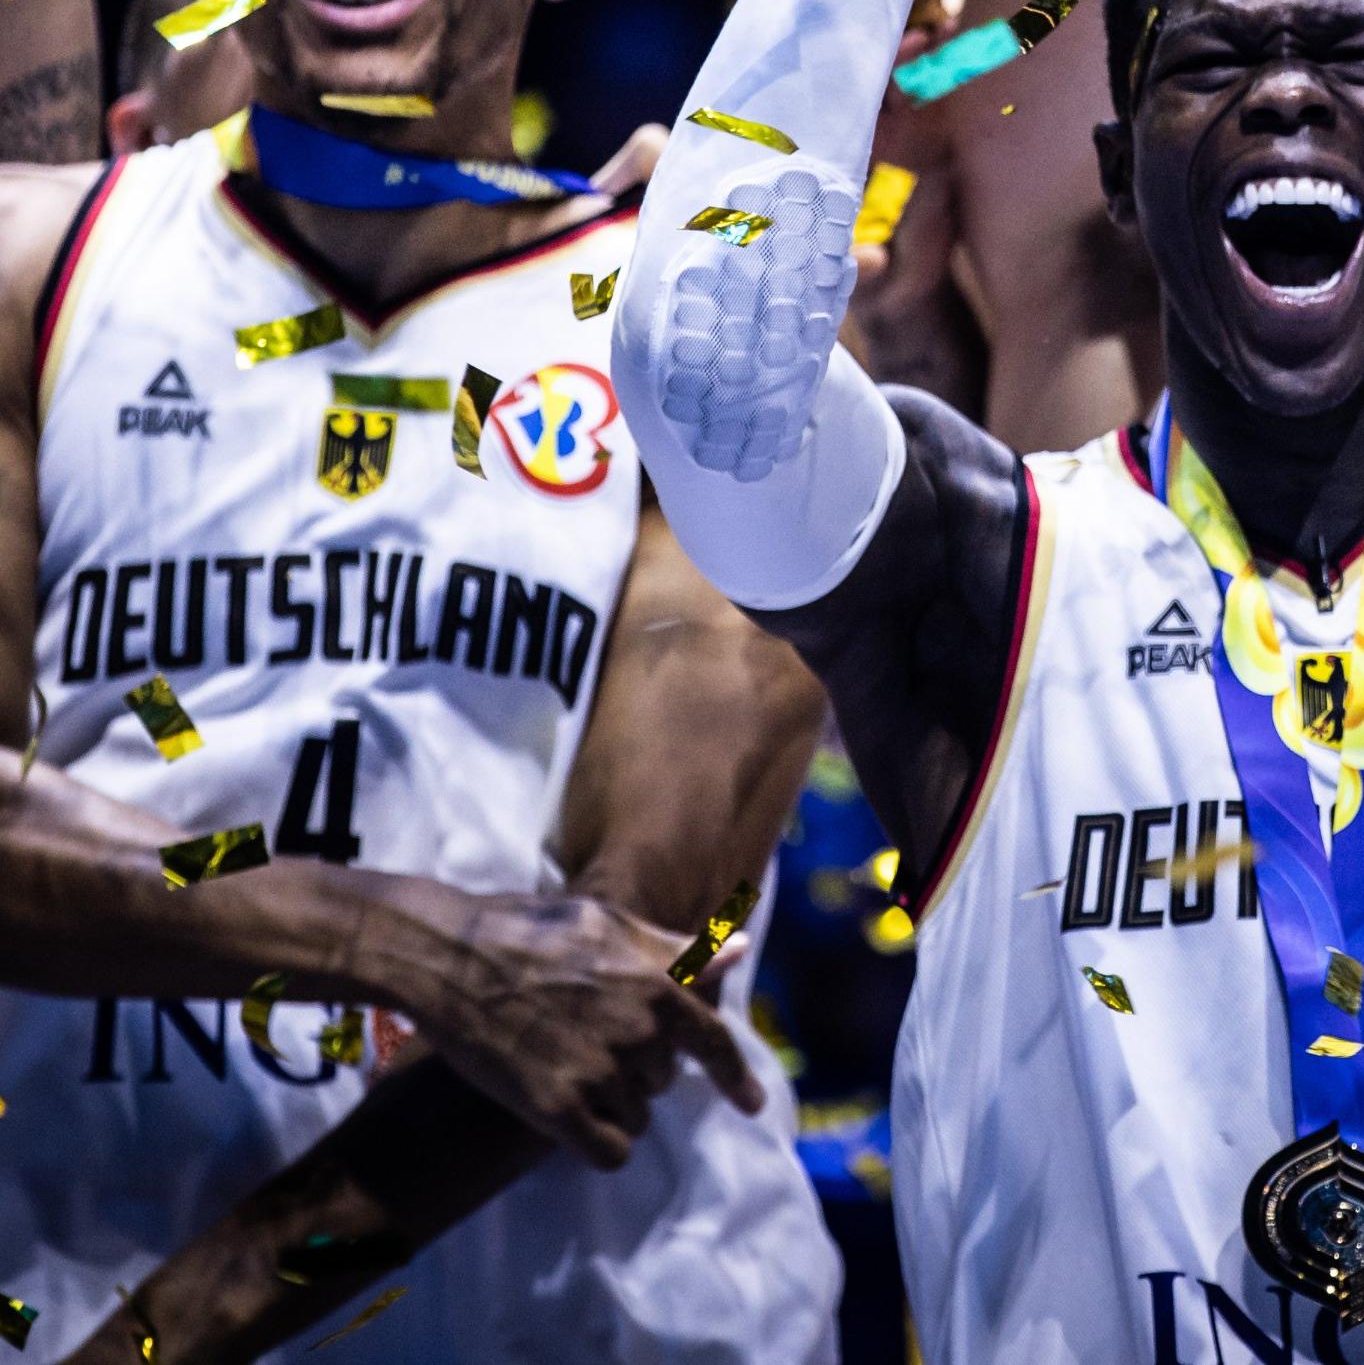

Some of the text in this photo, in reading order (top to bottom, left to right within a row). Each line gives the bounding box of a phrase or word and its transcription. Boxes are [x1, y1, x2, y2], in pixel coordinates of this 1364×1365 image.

[117, 405, 212, 438] PEAK
[61, 550, 597, 711] DEUTSCHLAND
[1126, 643, 1213, 679] PEAK
[275, 718, 361, 865] 4
